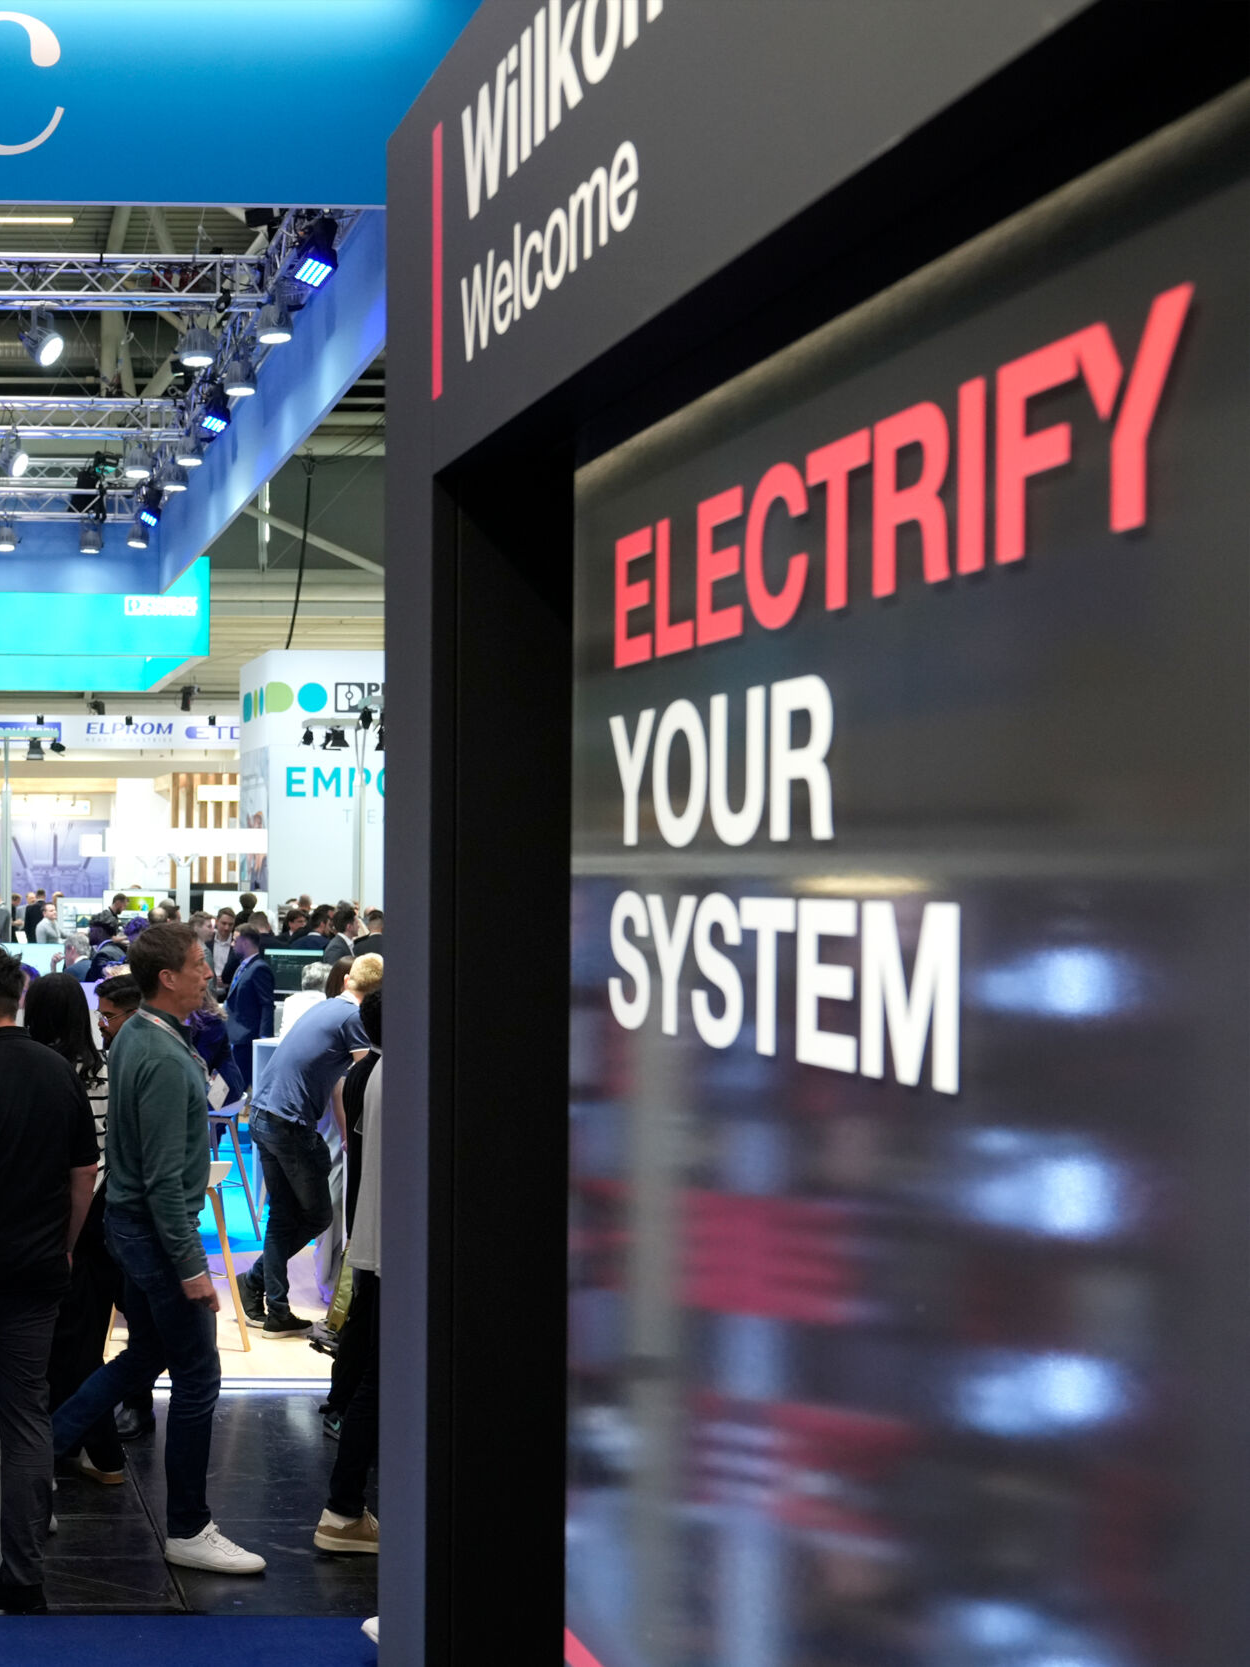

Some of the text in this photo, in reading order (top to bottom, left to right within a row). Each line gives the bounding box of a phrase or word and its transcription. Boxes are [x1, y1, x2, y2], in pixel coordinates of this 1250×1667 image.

[461, 141, 639, 363] Welcome
[614, 282, 1195, 670] ELECTRIFY
[86, 722, 174, 735] ELPROM
[609, 674, 834, 848] YOUR
[607, 890, 961, 1095] SYSTEM
